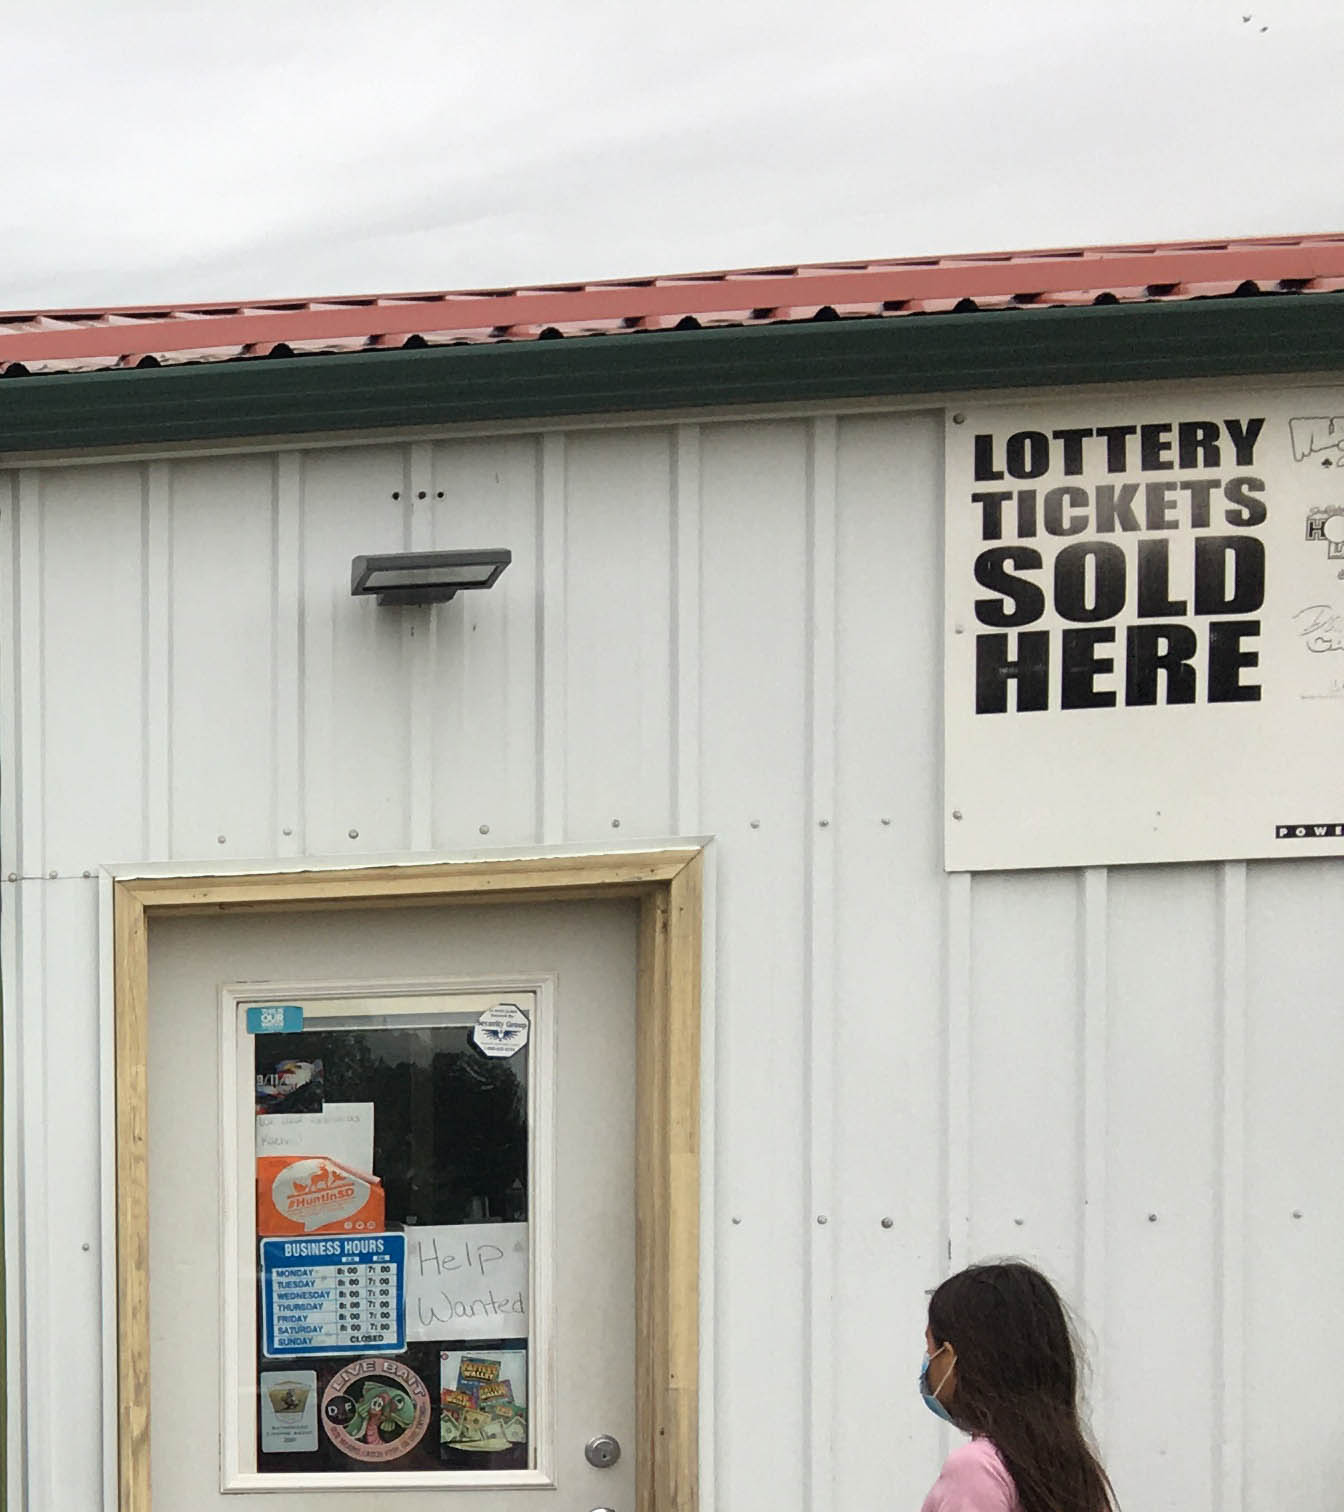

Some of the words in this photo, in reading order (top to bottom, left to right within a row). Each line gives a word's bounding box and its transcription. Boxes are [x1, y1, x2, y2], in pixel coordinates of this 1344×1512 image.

[974, 417, 1266, 482] LOTTERY
[971, 476, 1267, 541] TICKETS
[974, 535, 1266, 628] SOLD
[975, 620, 1262, 715] HERE
[285, 1241, 341, 1256] BUSINESS
[345, 1240, 384, 1253] HOURS
[277, 1280, 315, 1289] TUESDAY
[277, 1291, 330, 1300] WEDNESDAY
[277, 1303, 323, 1311] THURSDAY
[418, 1290, 525, 1326] Wanted
[277, 1315, 308, 1323] FRIDAY
[278, 1326, 323, 1334] SATURDAY
[278, 1337, 312, 1346] SUNDAY
[350, 1335, 384, 1343] CLOSED
[331, 1360, 376, 1392] LIVE
[383, 1361, 426, 1397] BAIT
